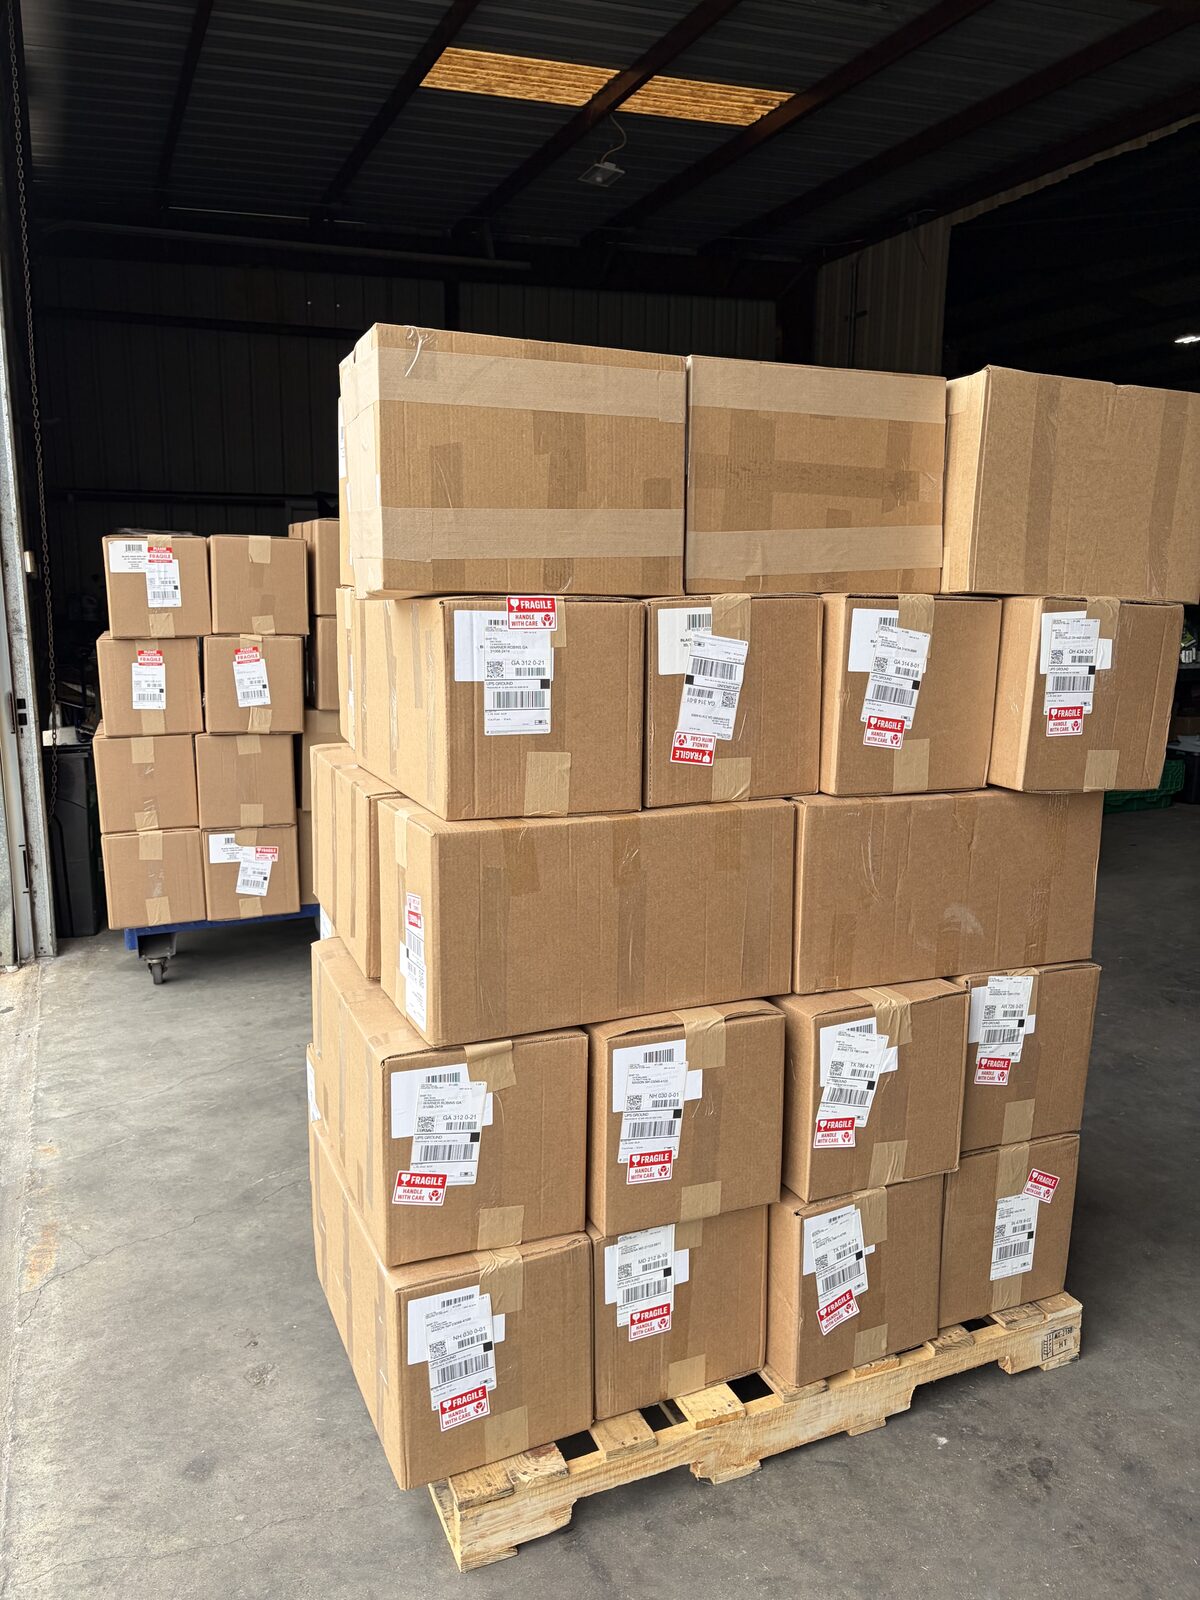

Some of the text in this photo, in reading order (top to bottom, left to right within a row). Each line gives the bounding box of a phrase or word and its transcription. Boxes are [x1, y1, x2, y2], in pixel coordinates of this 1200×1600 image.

[520, 600, 552, 609] FRAGILE
[1058, 709, 1081, 718] FRAGILE
[877, 720, 903, 731] FRAGILE
[675, 750, 703, 760] FRAGILE
[987, 1060, 1009, 1068] FRAGILE
[827, 1120, 853, 1129] FRAGILE
[641, 1153, 669, 1164] FRAGILE
[411, 1176, 444, 1185] FRAGILE
[1037, 1175, 1056, 1186] FRAGILE
[827, 1293, 851, 1313] FRAGILE
[641, 1306, 668, 1320] FRAGILE
[826, 1312, 840, 1323] HANDLE
[636, 1322, 653, 1330] HANDLE
[824, 1314, 843, 1329] WITH CARE
[474, 1326, 486, 1334] 0-01
[644, 1326, 656, 1334] CARE
[1058, 1339, 1067, 1348] HT
[453, 1389, 484, 1408] FRAGILE
[448, 1407, 468, 1418] HANDLE
[445, 1412, 471, 1426] WITH CARE
